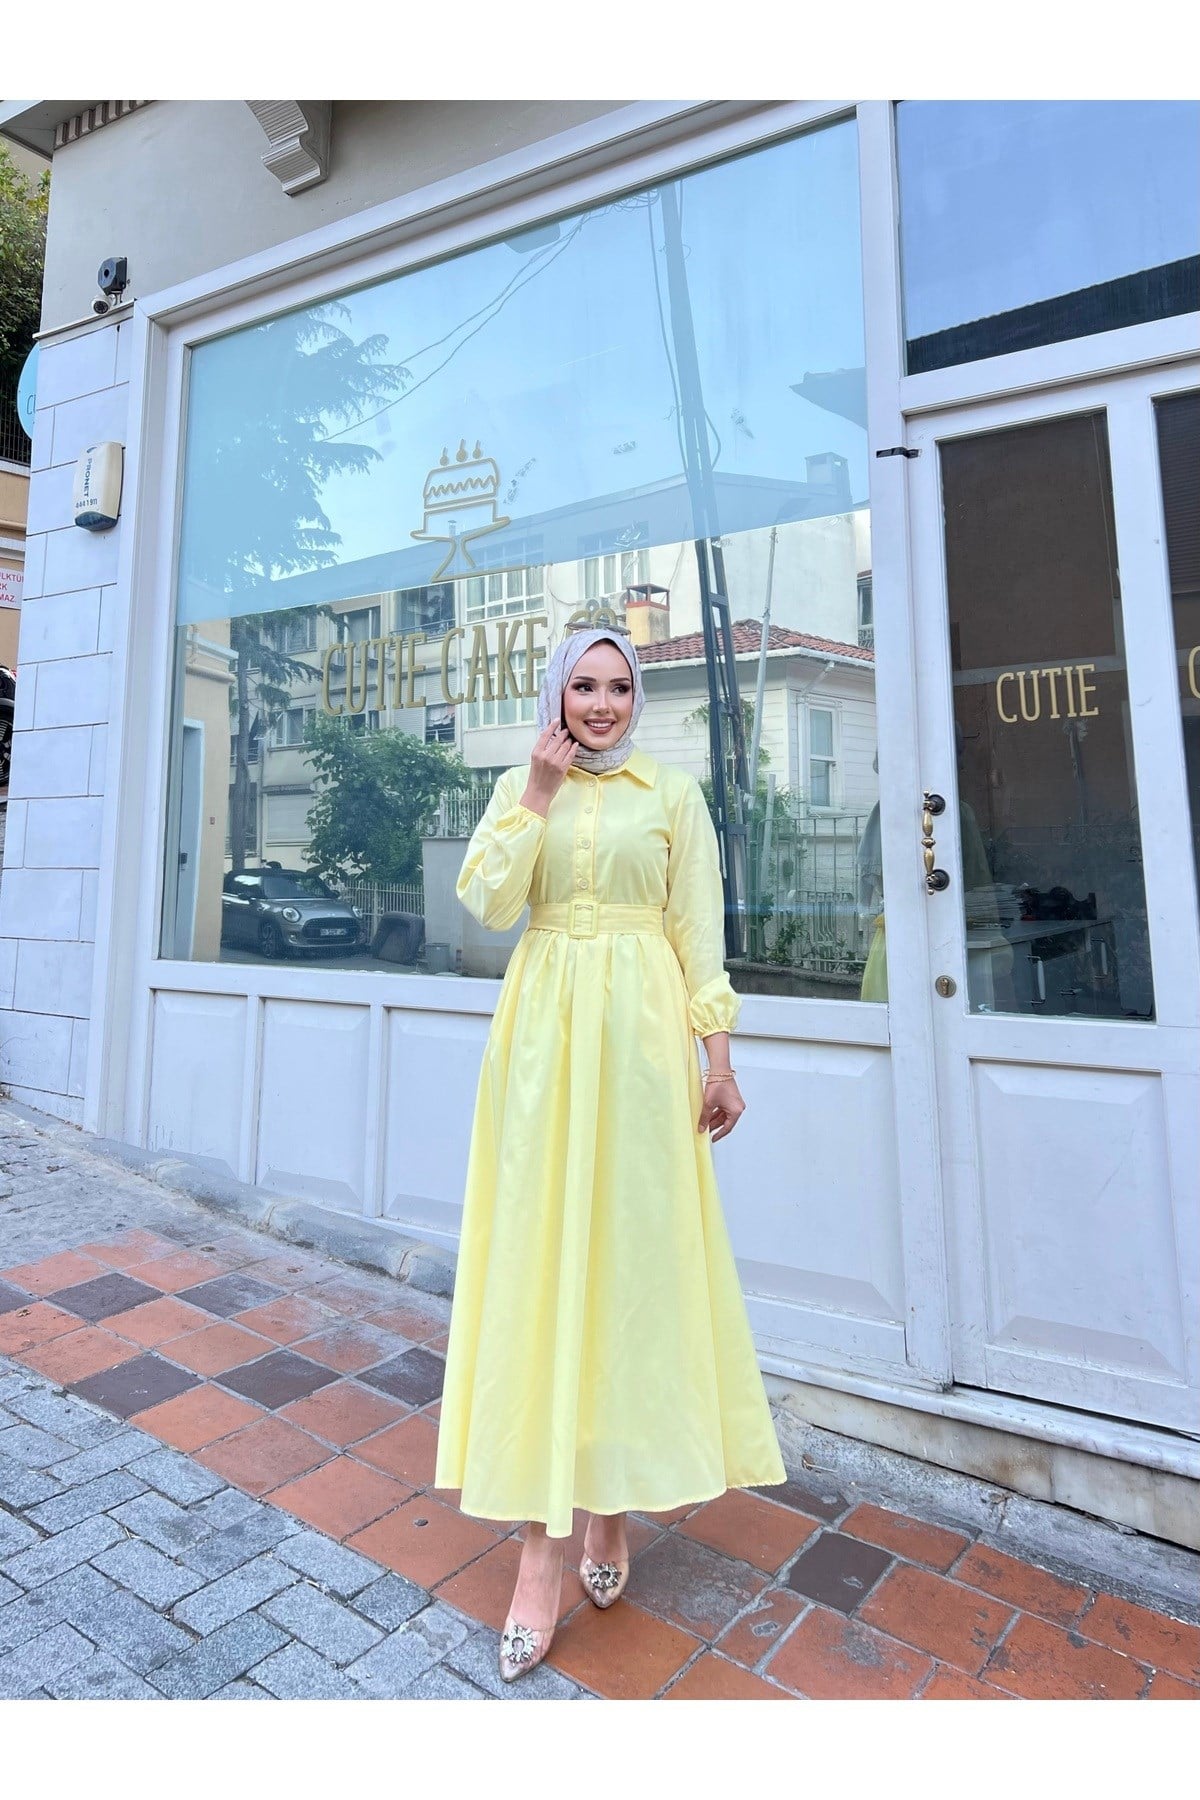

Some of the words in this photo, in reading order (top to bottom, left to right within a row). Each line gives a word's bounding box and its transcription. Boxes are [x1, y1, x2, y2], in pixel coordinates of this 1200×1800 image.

[84, 458, 93, 497] PRONET
[322, 632, 427, 716] CUTIE
[440, 616, 548, 705] CAKE
[996, 663, 1099, 723] CUTIE
